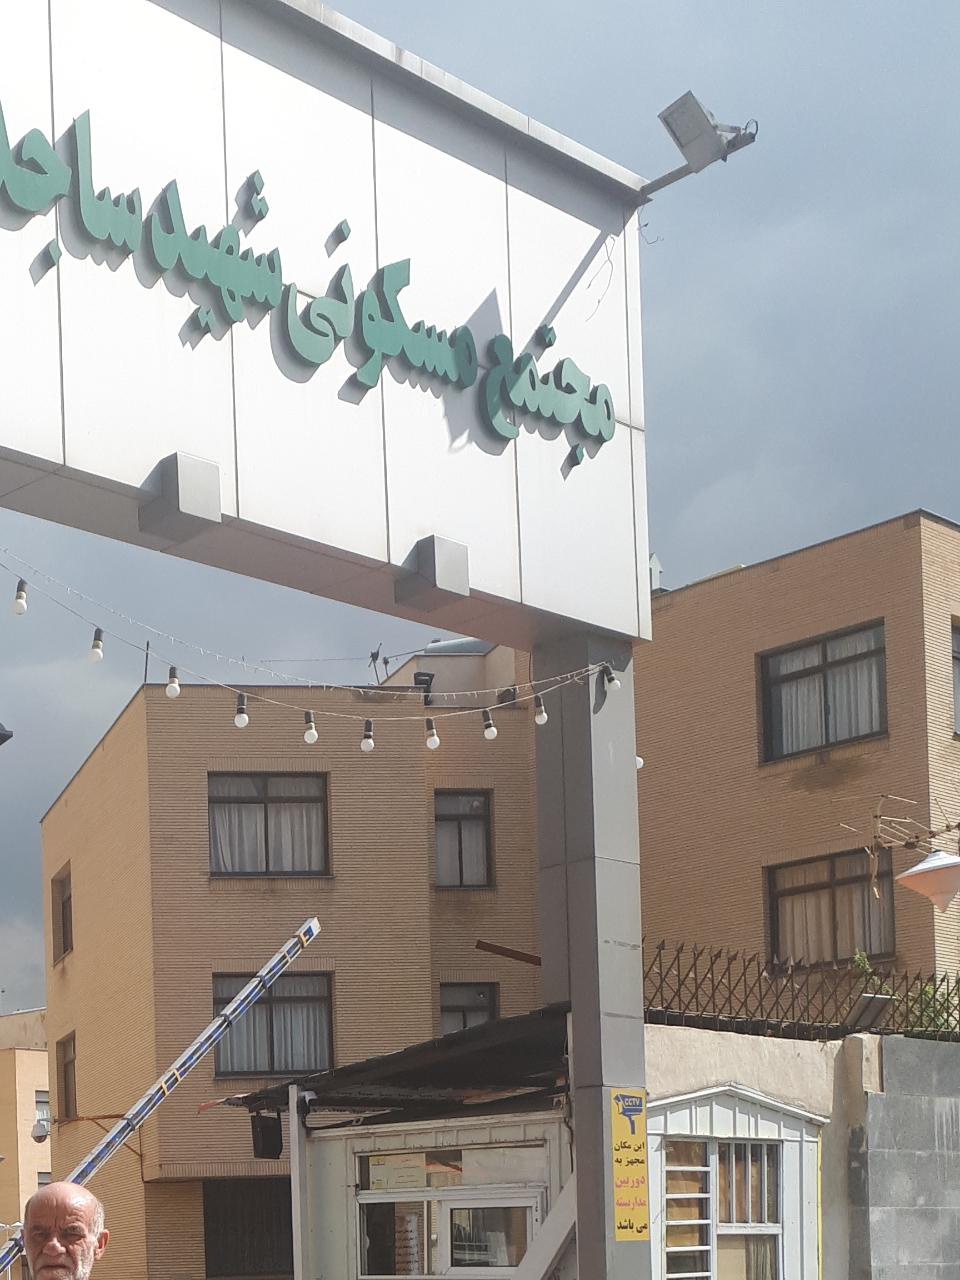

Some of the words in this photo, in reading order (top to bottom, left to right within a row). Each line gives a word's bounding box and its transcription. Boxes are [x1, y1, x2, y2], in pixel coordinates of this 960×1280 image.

[148, 170, 283, 331] شهید
[286, 219, 478, 388] مسکونی
[485, 324, 616, 466] مجتمع
[624, 1097, 641, 1106] CCTV
[614, 1141, 631, 1151] مکان
[633, 1141, 645, 1152] این
[614, 1157, 623, 1165] به
[625, 1157, 645, 1167] مجهز
[615, 1176, 645, 1188] دوربین
[617, 1218, 634, 1232] باشد
[635, 1221, 648, 1233] می
